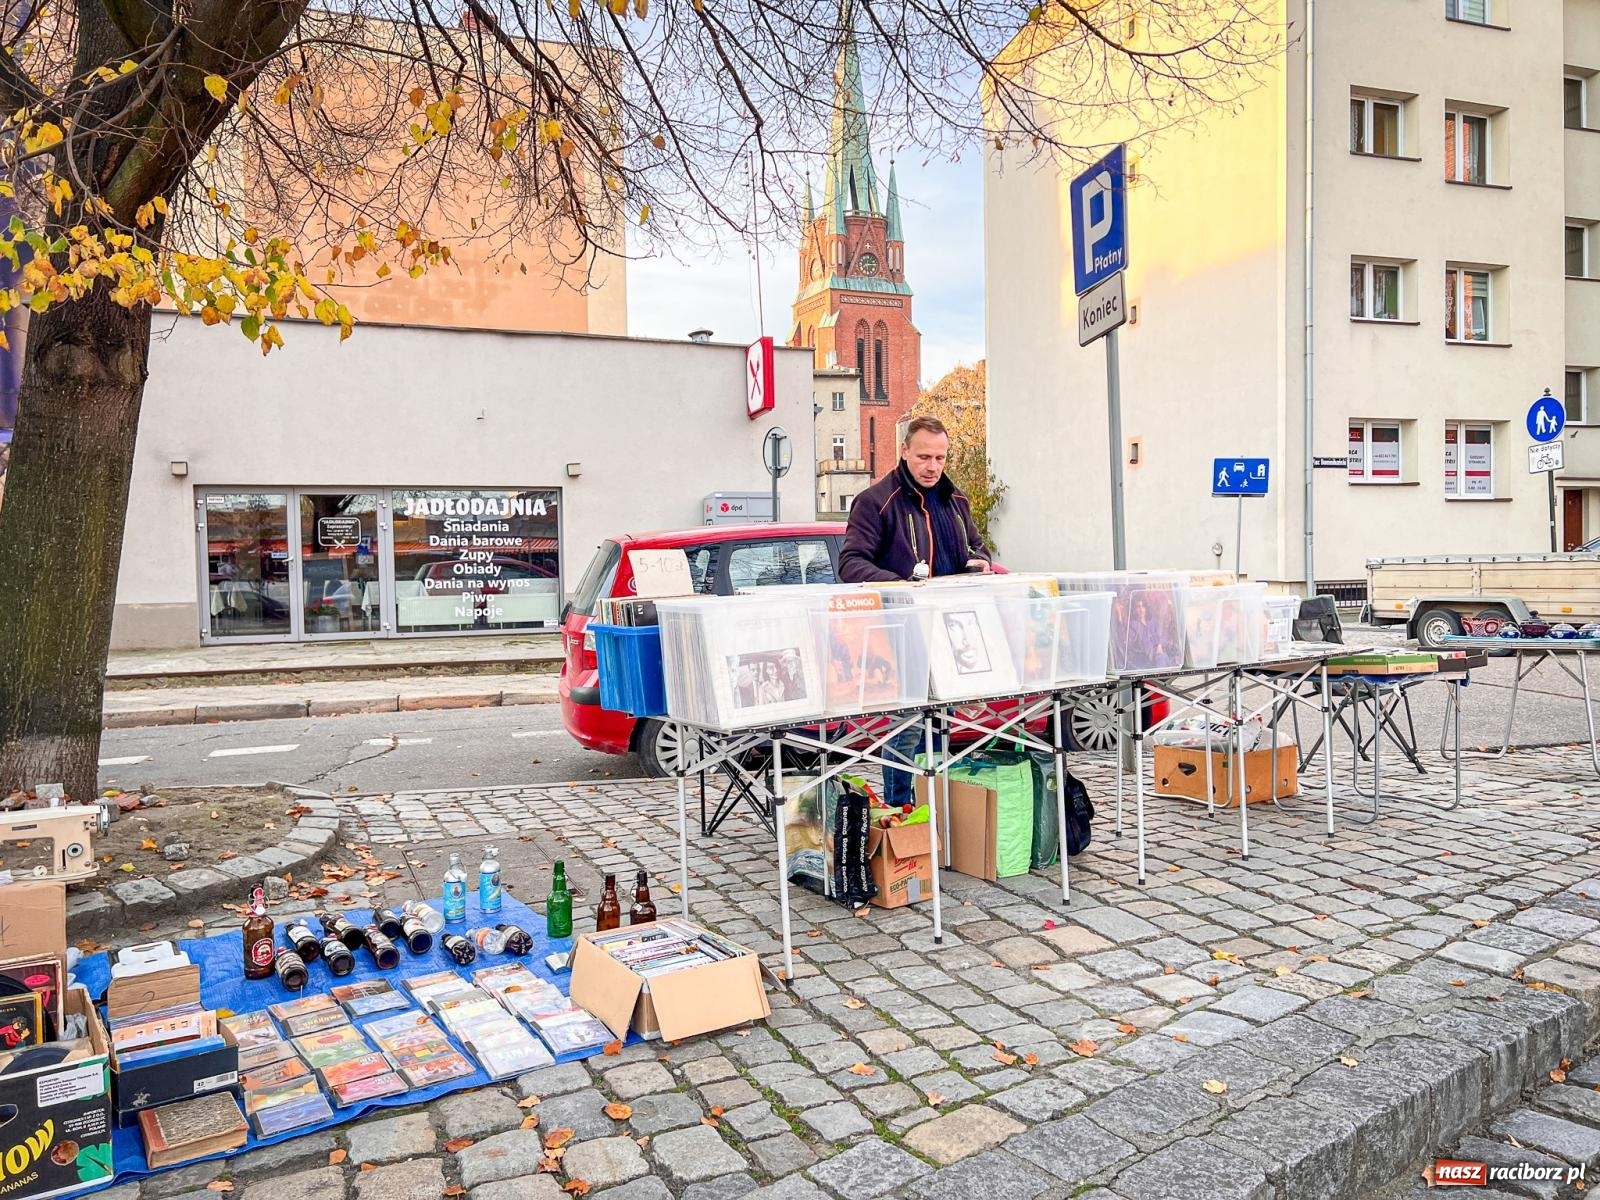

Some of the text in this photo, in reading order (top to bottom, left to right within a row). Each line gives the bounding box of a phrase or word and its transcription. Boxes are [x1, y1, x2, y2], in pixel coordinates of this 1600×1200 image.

[1082, 170, 1112, 274] P
[1094, 247, 1122, 274] Płatny
[1083, 295, 1118, 330] Koniec
[404, 498, 547, 516] JADŁODAJNIA
[444, 518, 509, 532] Śniadania
[430, 535, 522, 546] Dania barowe
[459, 549, 494, 563] Zupy
[453, 563, 501, 576] Obiady
[424, 578, 530, 591] Dania na wynos
[462, 592, 495, 603] Piwo
[846, 598, 875, 608] BONGO
[455, 606, 503, 619] Napoje
